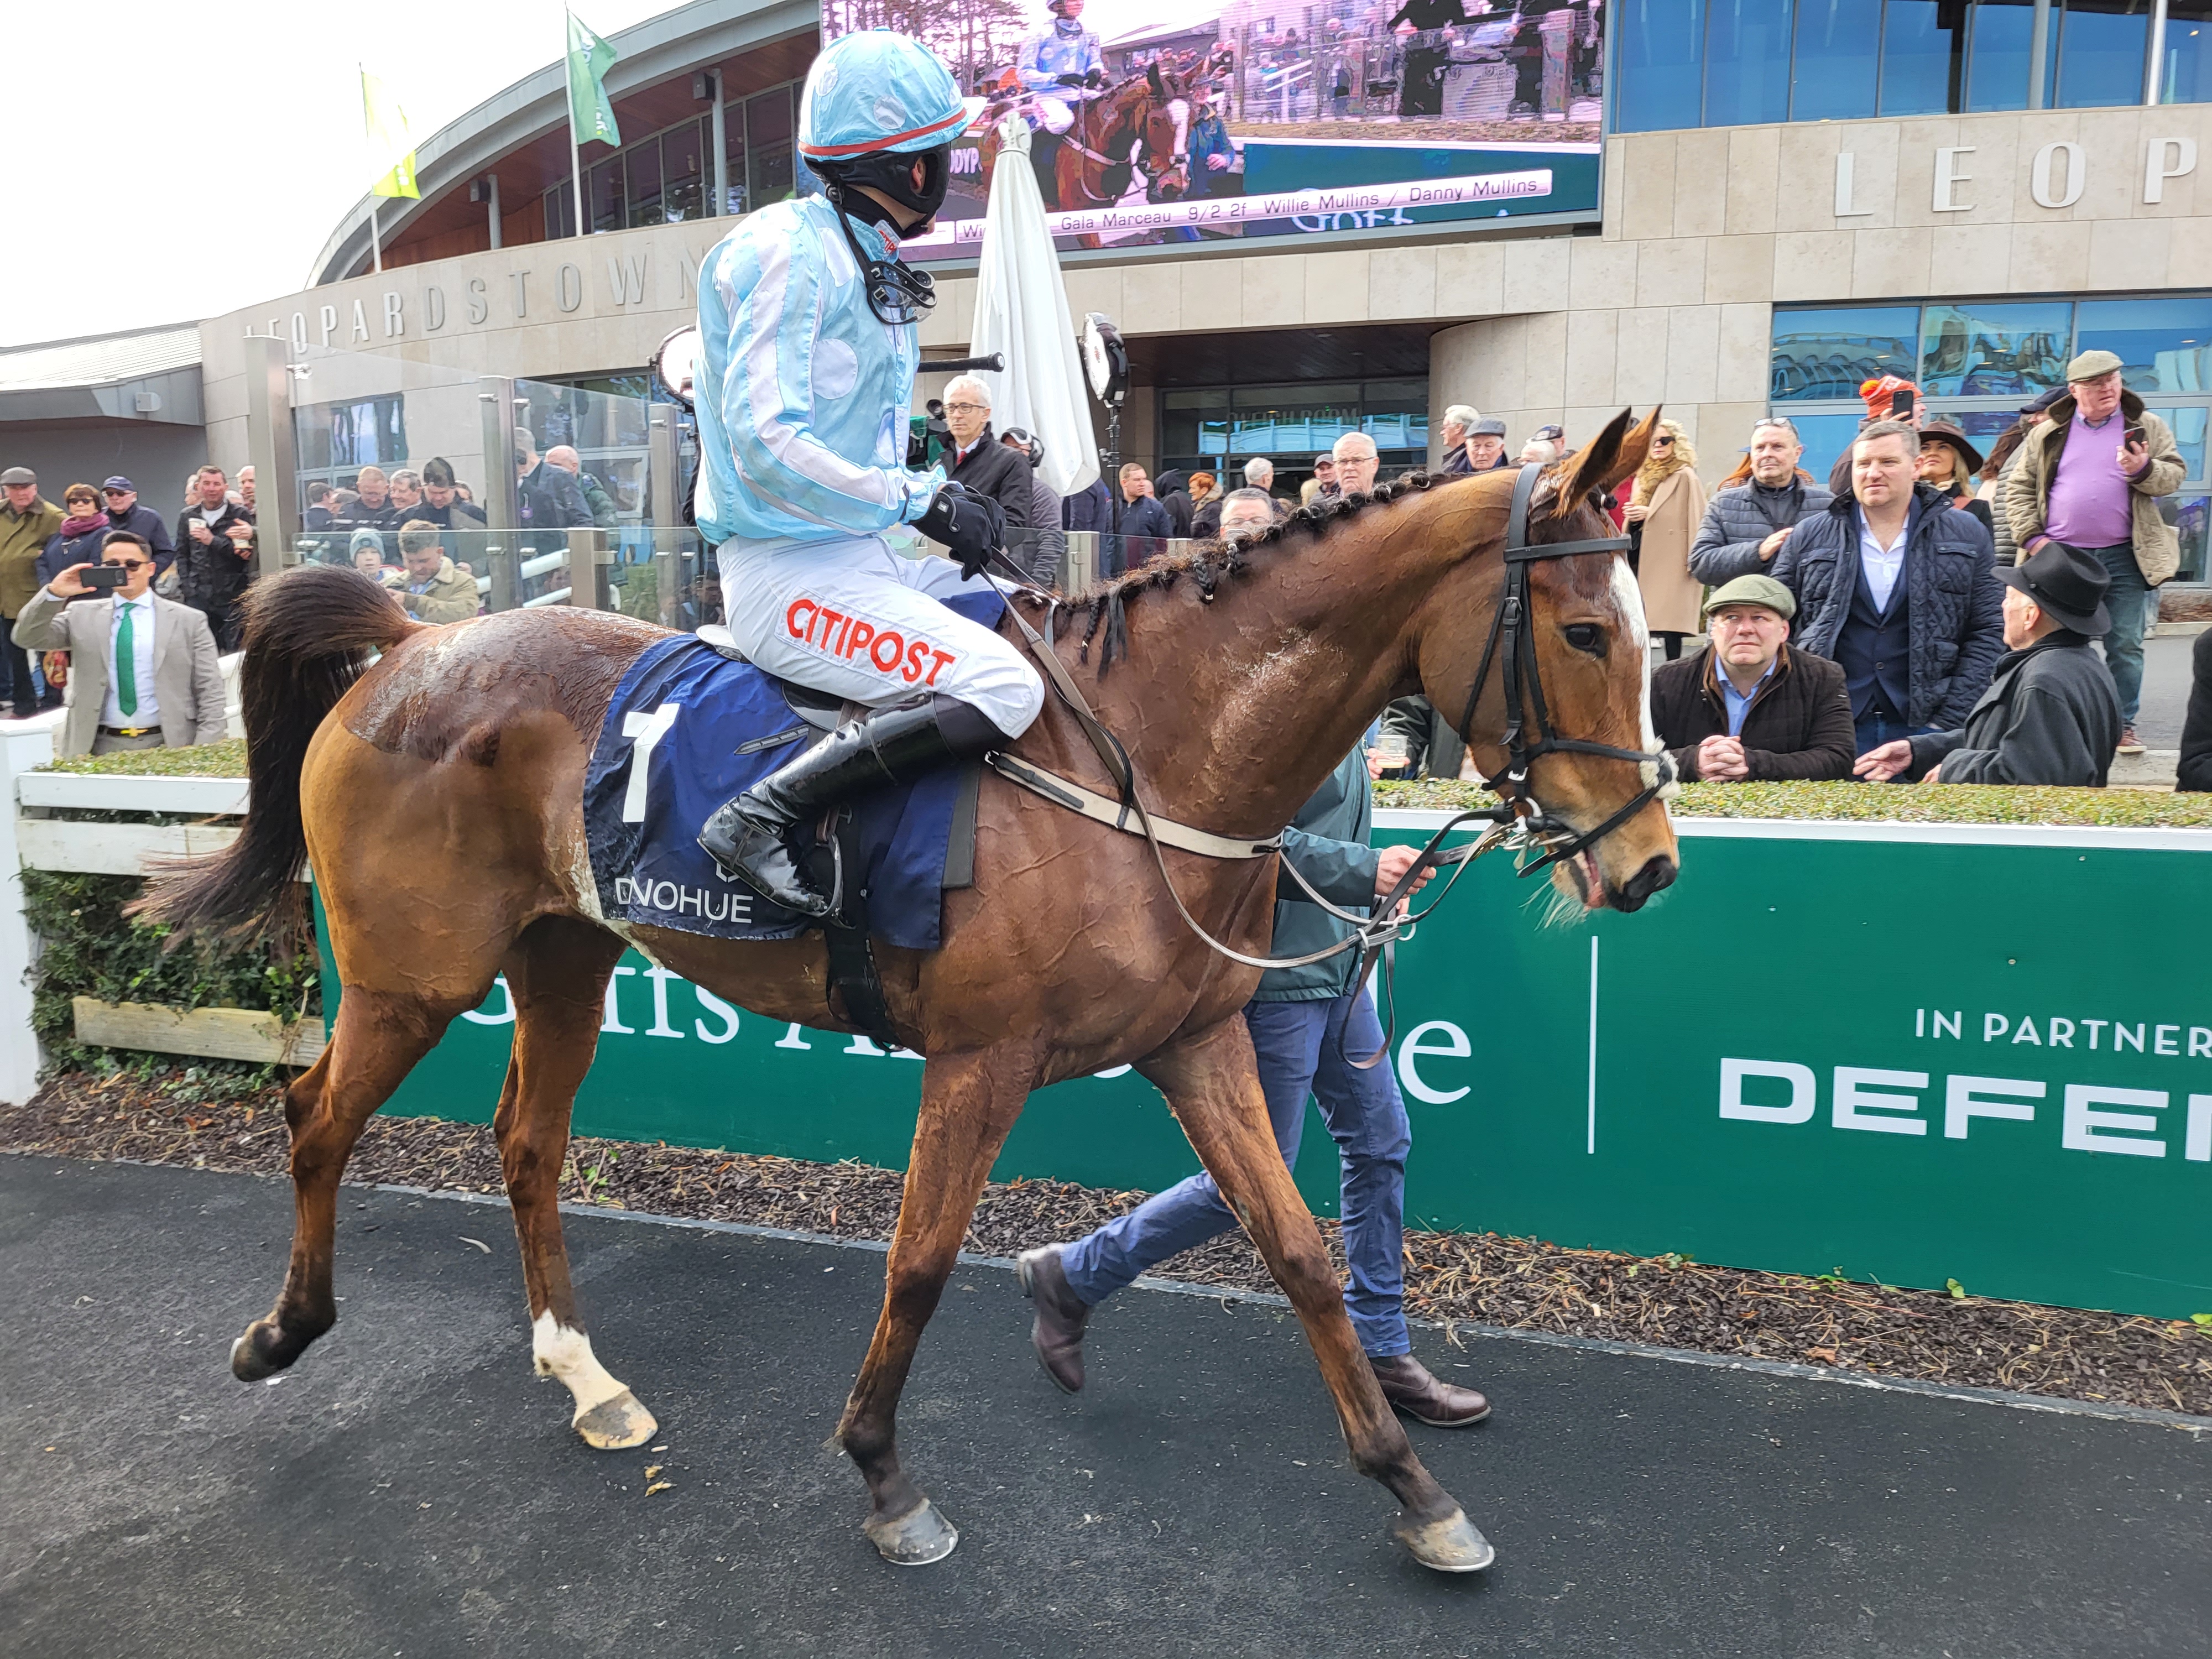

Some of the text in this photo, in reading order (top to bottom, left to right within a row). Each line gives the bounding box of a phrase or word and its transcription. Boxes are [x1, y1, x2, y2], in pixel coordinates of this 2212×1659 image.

[1061, 216, 1094, 231] Gala
[1102, 213, 1171, 227] Marceau
[1188, 205, 1220, 222] 9/2
[1230, 202, 1247, 217] 2f
[1264, 196, 1310, 215] Willie
[1319, 192, 1379, 210] Mullins
[1410, 187, 1463, 202] Danny
[1473, 179, 1537, 197] Mullins
[786, 599, 956, 687] CITIPOST
[1915, 1009, 2212, 1057] IN PARTNER
[1719, 1057, 2212, 1161] DEFE
